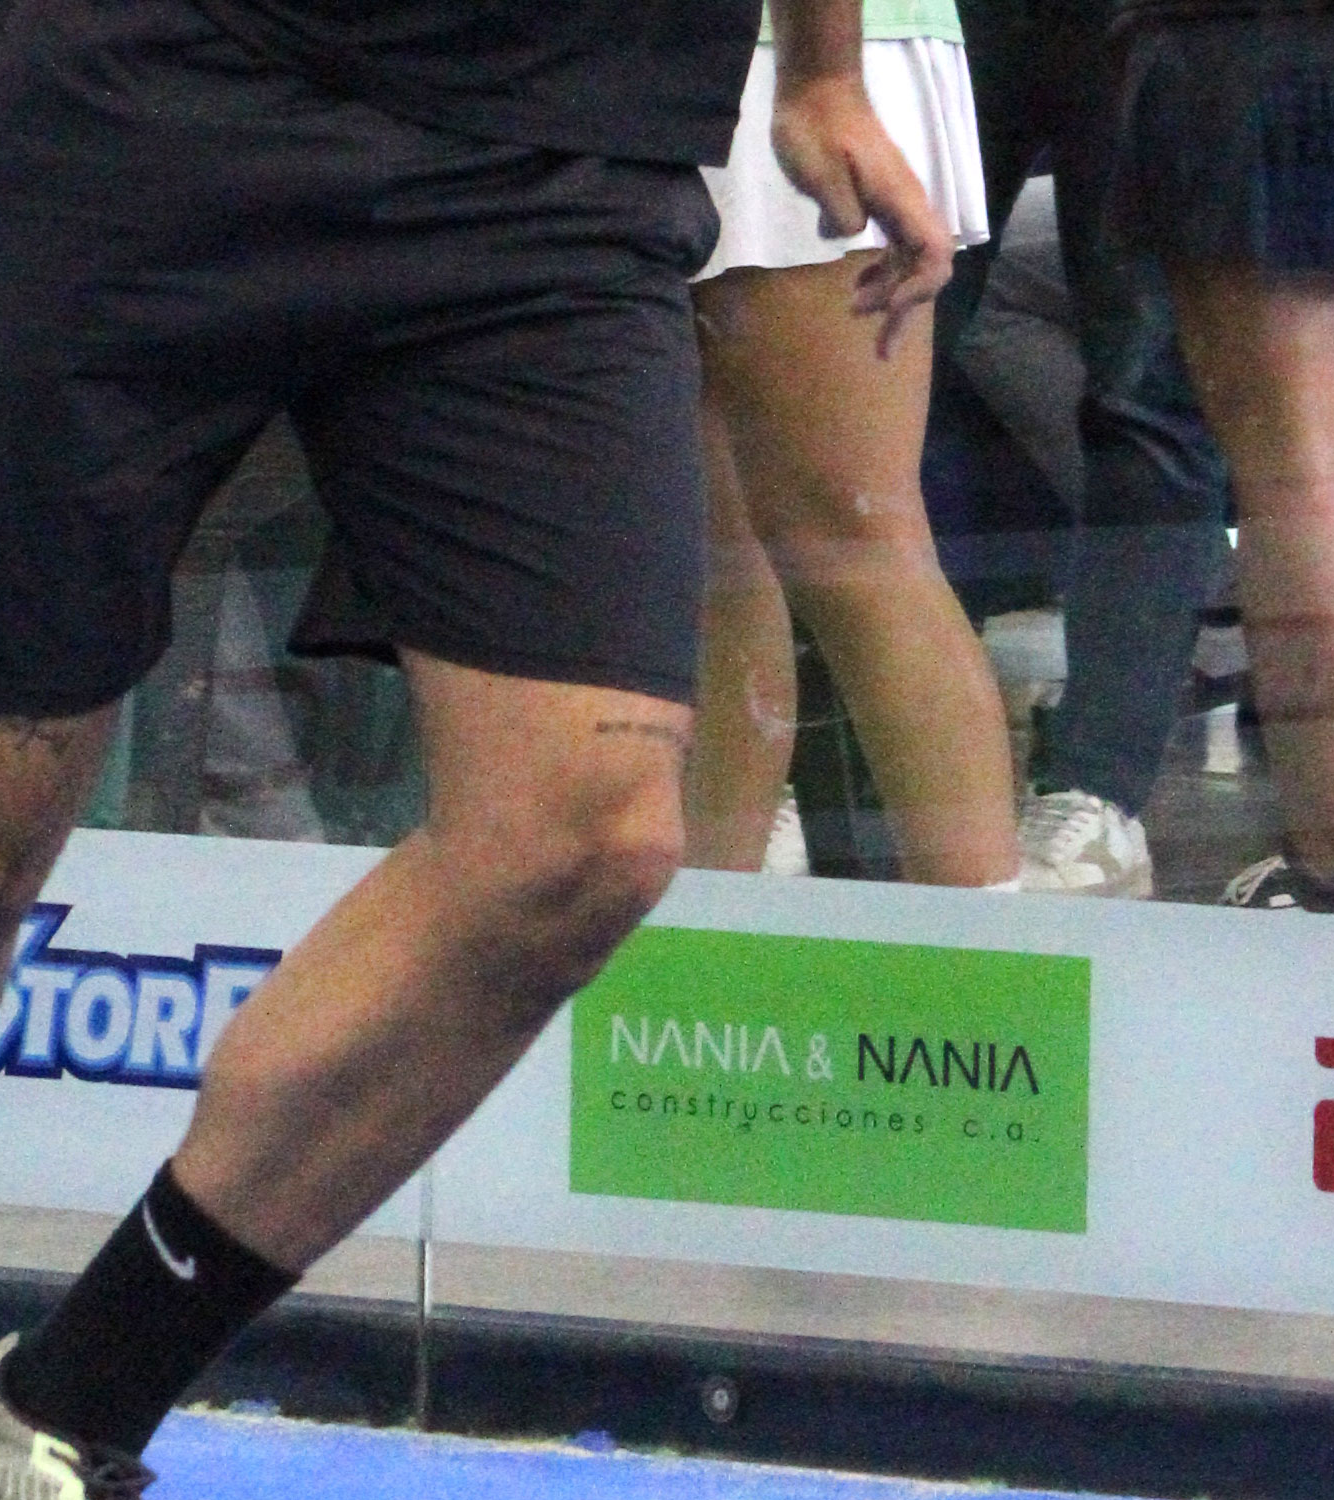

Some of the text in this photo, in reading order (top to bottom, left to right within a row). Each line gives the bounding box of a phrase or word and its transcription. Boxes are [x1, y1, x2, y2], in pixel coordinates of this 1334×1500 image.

[610, 1014, 1040, 1095] NANIA & NANIA
[611, 1088, 1040, 1144] construcciones c.a.
